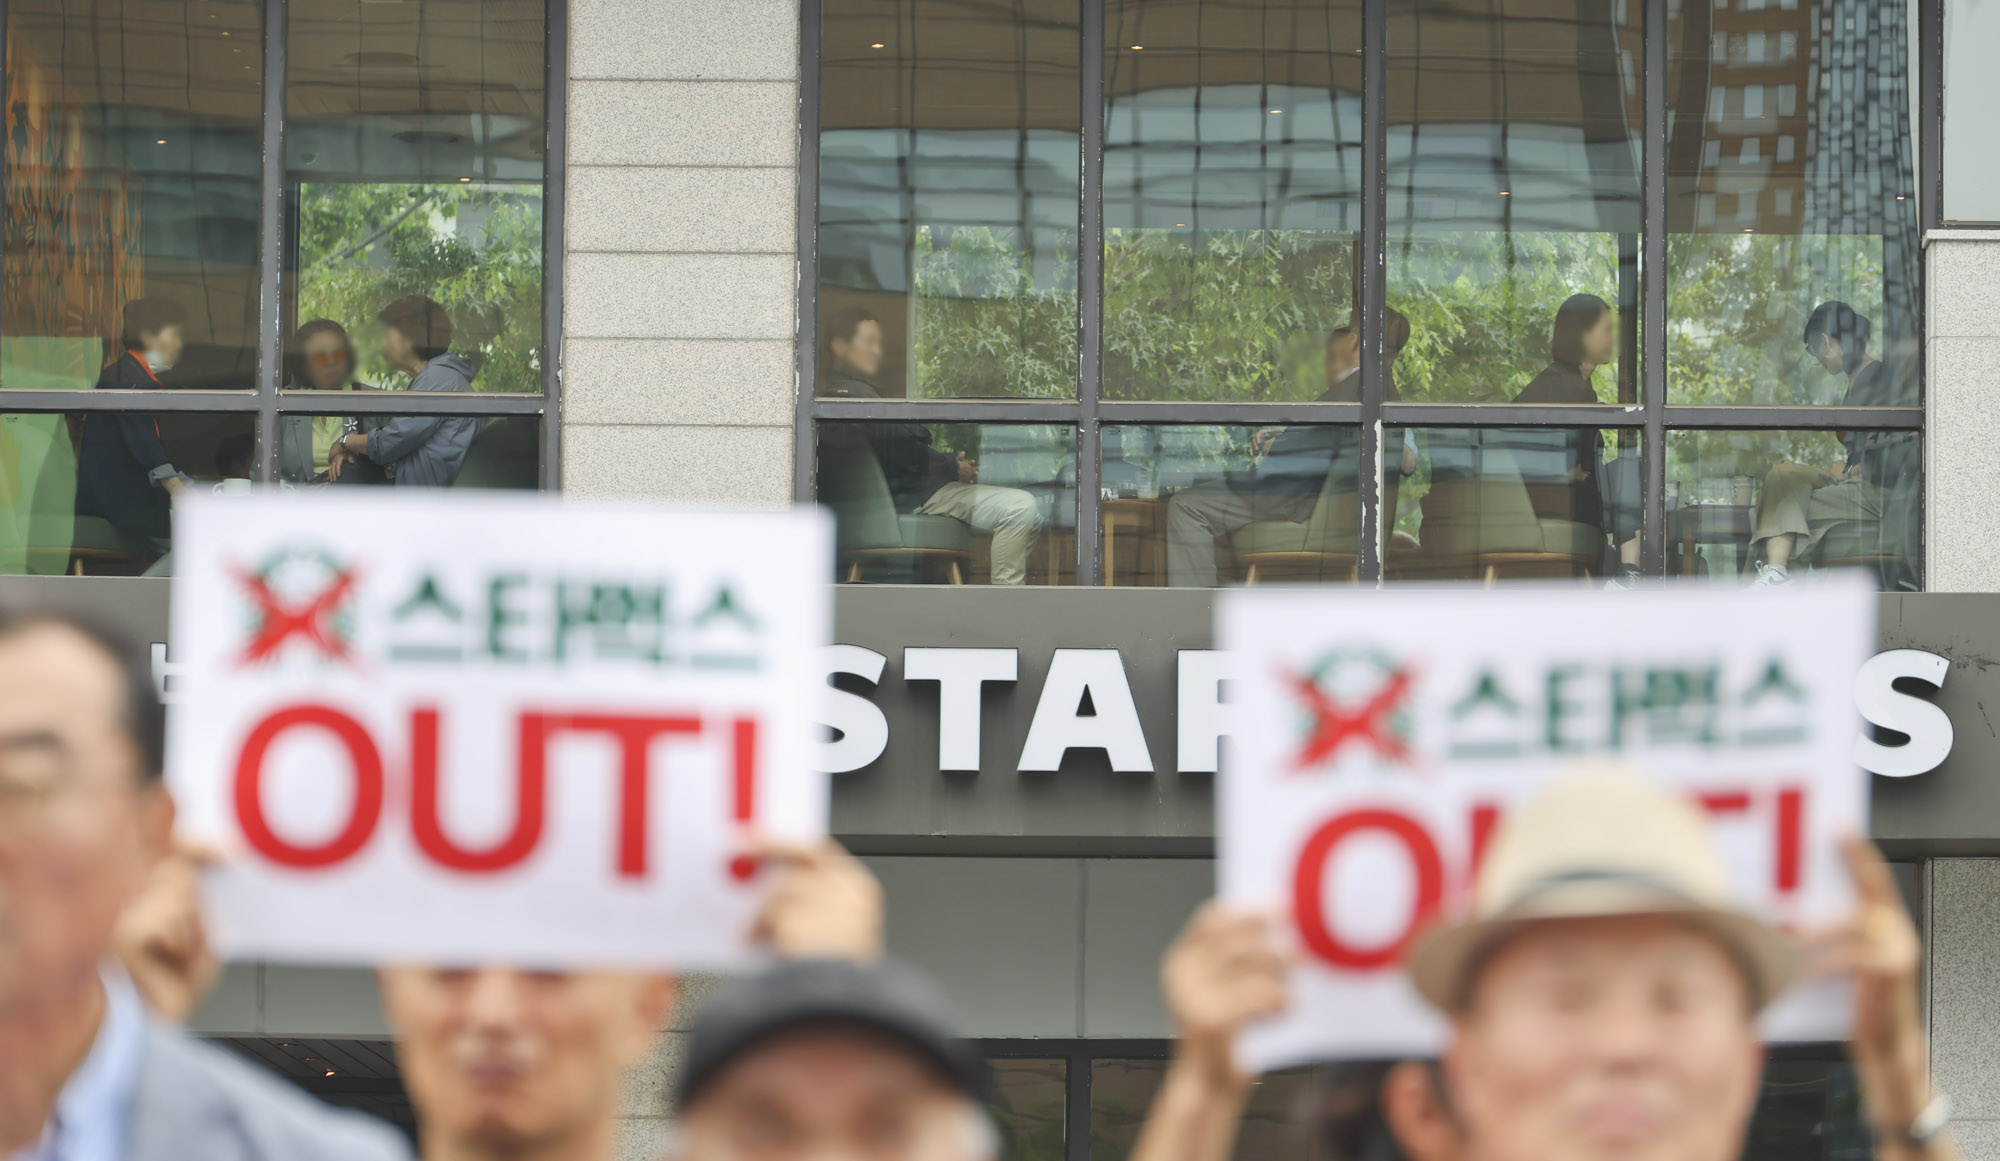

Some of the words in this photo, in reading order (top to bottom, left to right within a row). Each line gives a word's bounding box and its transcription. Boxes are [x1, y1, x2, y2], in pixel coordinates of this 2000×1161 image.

[384, 562, 767, 672] 스타벅스
[1445, 652, 1816, 760] 스타벅스
[230, 702, 762, 882] OUT!
